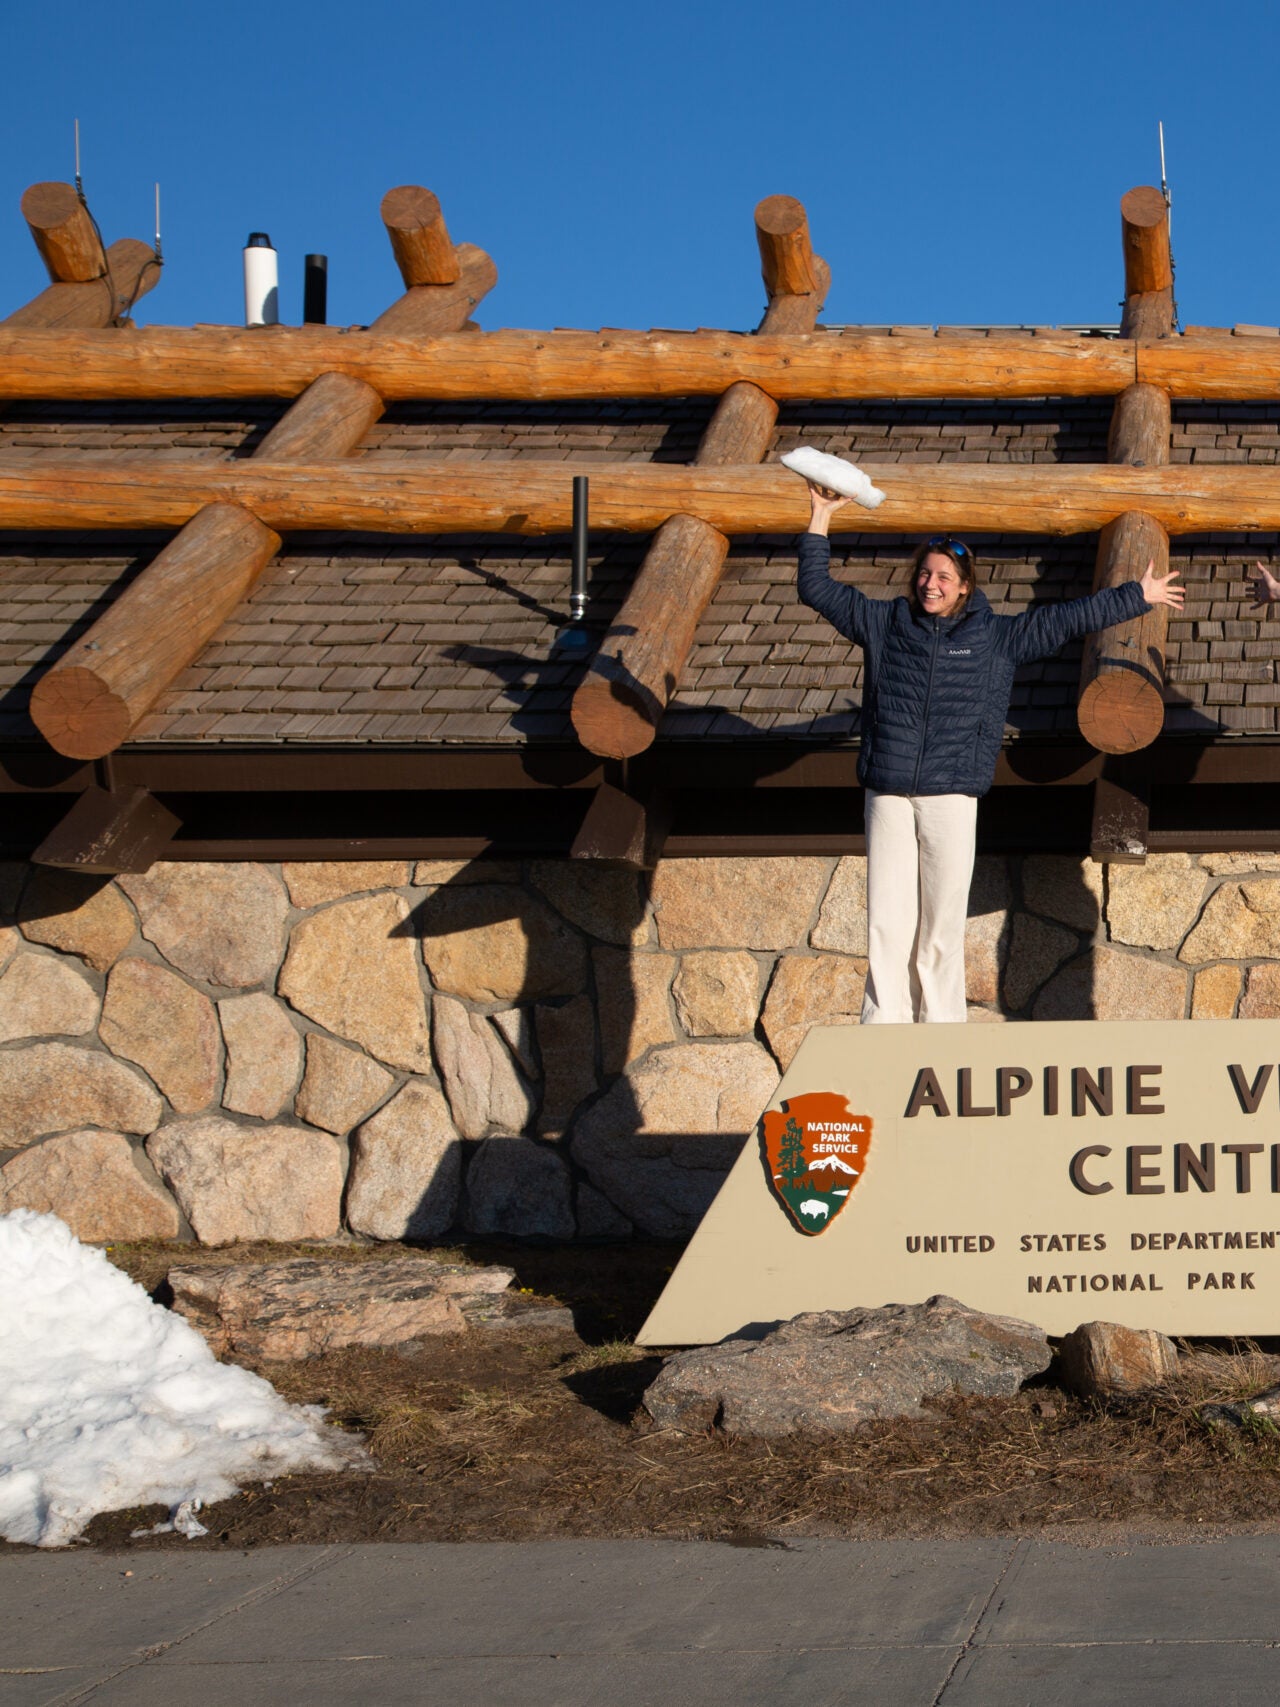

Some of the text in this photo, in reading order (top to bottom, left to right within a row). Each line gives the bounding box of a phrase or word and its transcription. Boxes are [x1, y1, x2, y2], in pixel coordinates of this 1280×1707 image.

[905, 1064, 1164, 1118] ALPINE
[807, 1122, 865, 1132] NATIONAL
[820, 1133, 851, 1143] PARK
[812, 1143, 859, 1154] SERVICE
[906, 1236, 995, 1254] UNITED
[1021, 1234, 1106, 1253] STATES
[1028, 1274, 1163, 1294] NATIONAL
[1188, 1272, 1255, 1291] PARK
